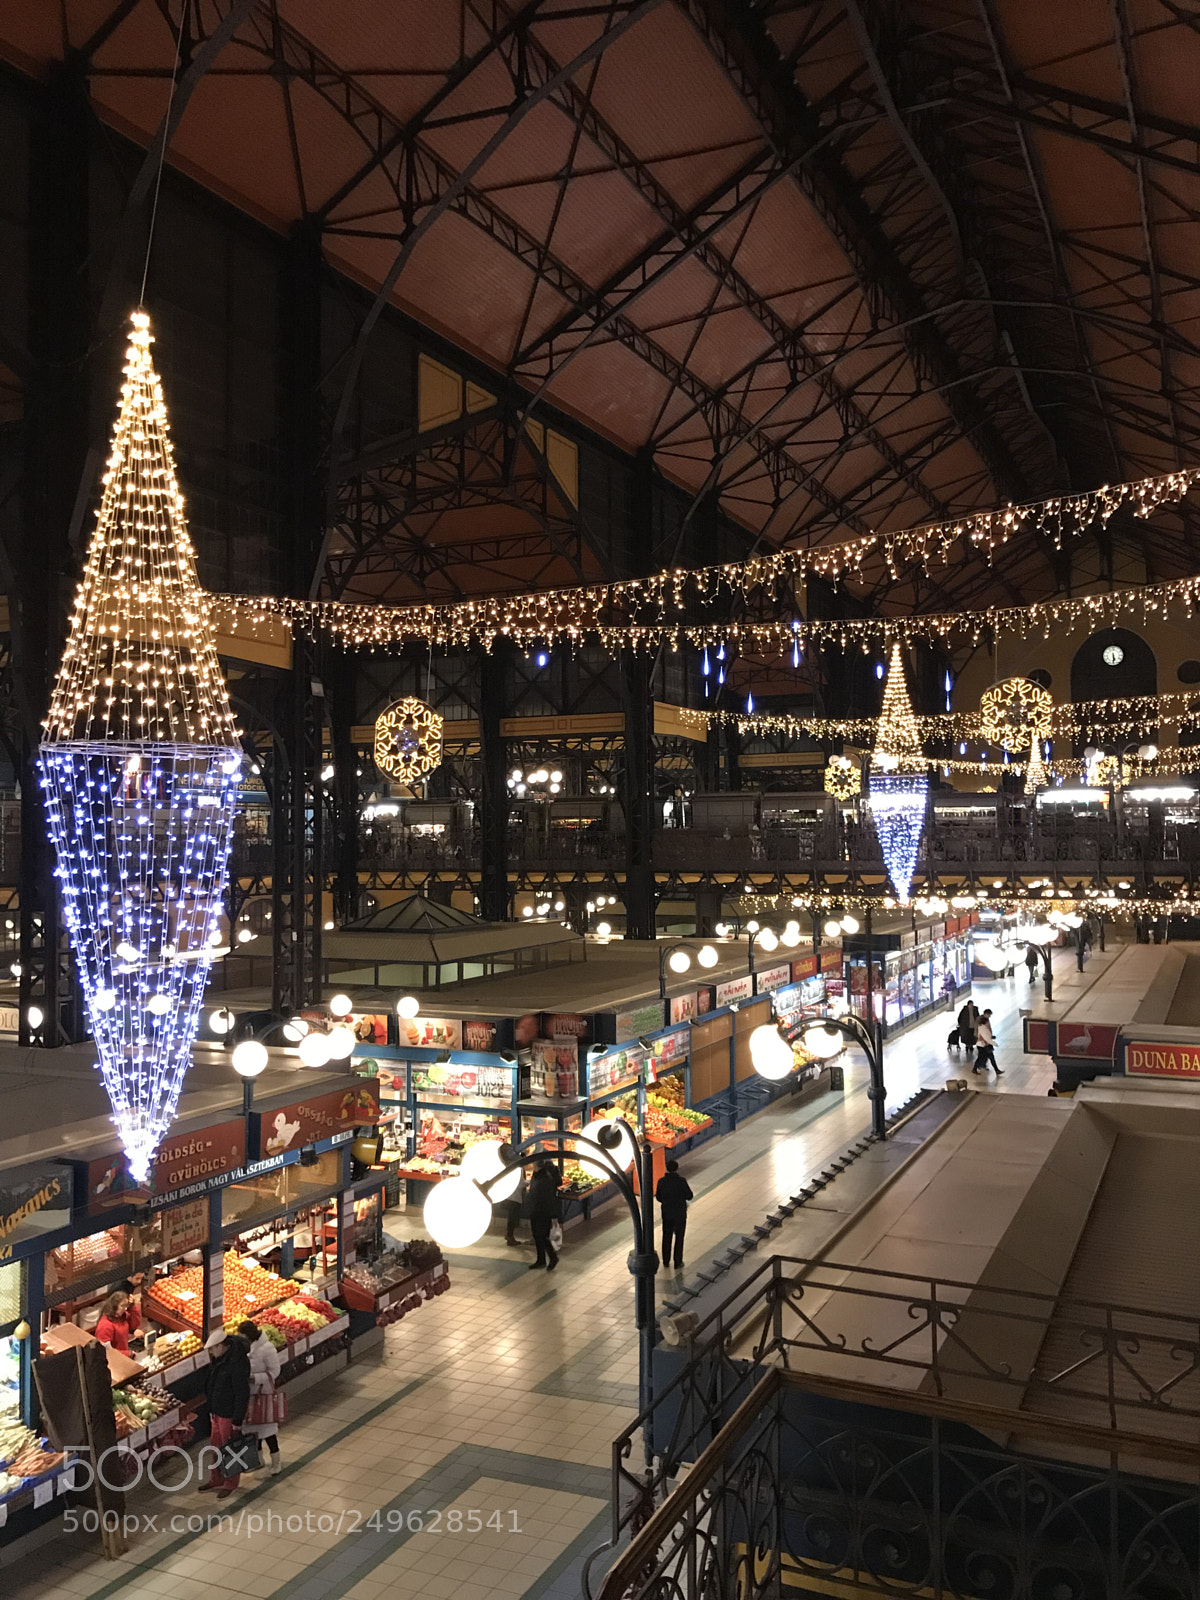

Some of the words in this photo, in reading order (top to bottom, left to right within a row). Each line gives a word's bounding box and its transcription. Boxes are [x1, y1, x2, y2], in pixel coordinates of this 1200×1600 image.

[1132, 1050, 1178, 1070] DUNA
[475, 1085, 504, 1098] JUICE
[297, 1105, 334, 1127] ORSZÁG
[169, 1156, 228, 1184] GYÜMÖLCS
[179, 1180, 207, 1198] BOROK
[208, 1172, 230, 1189] NAGY
